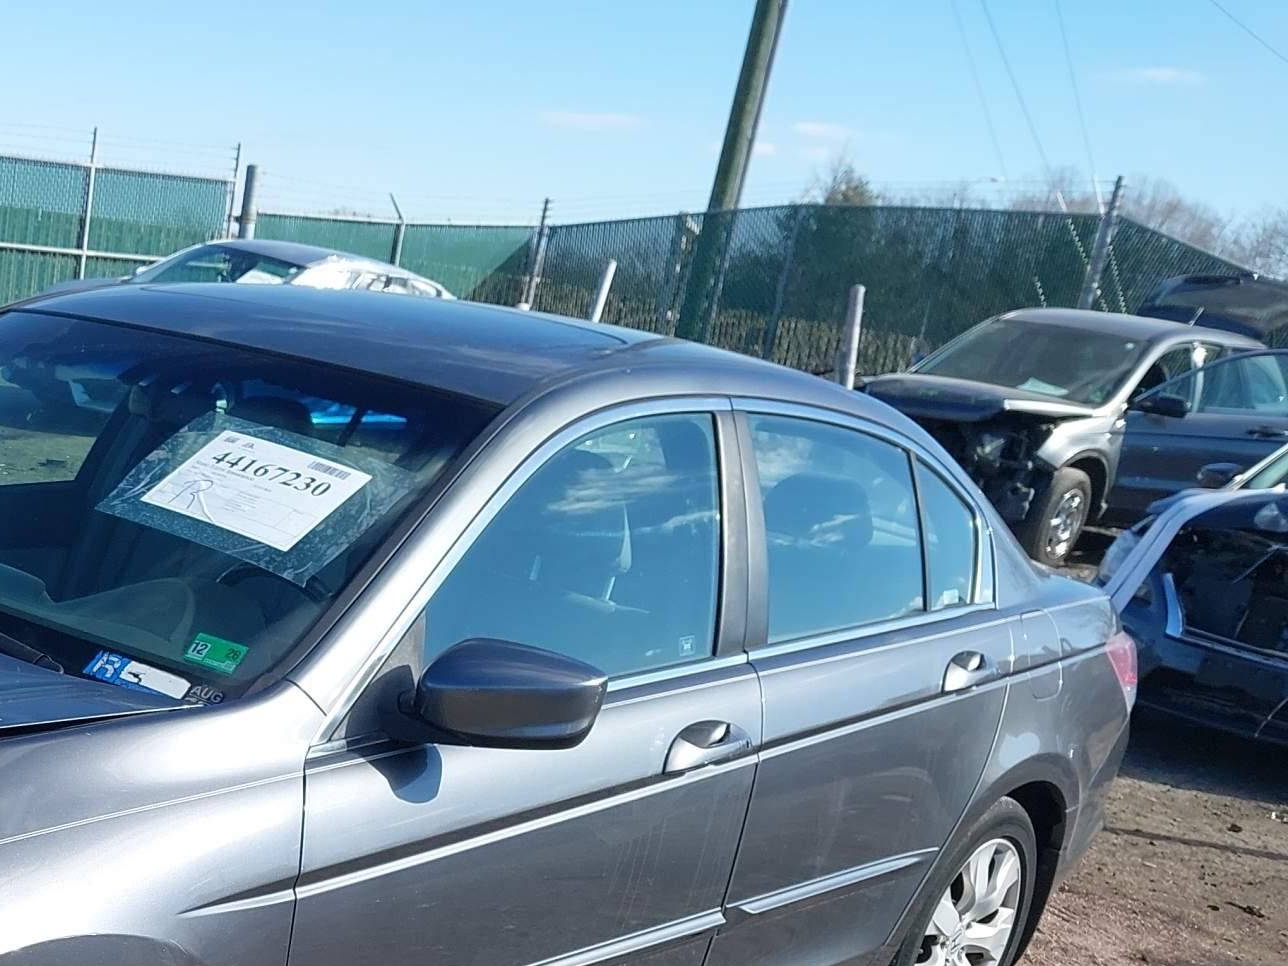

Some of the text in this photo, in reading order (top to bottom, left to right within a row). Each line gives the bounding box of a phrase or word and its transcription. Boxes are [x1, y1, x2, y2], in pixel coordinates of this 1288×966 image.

[212, 451, 331, 497] 44167230
[191, 641, 209, 656] 12
[189, 684, 224, 703] AUG
